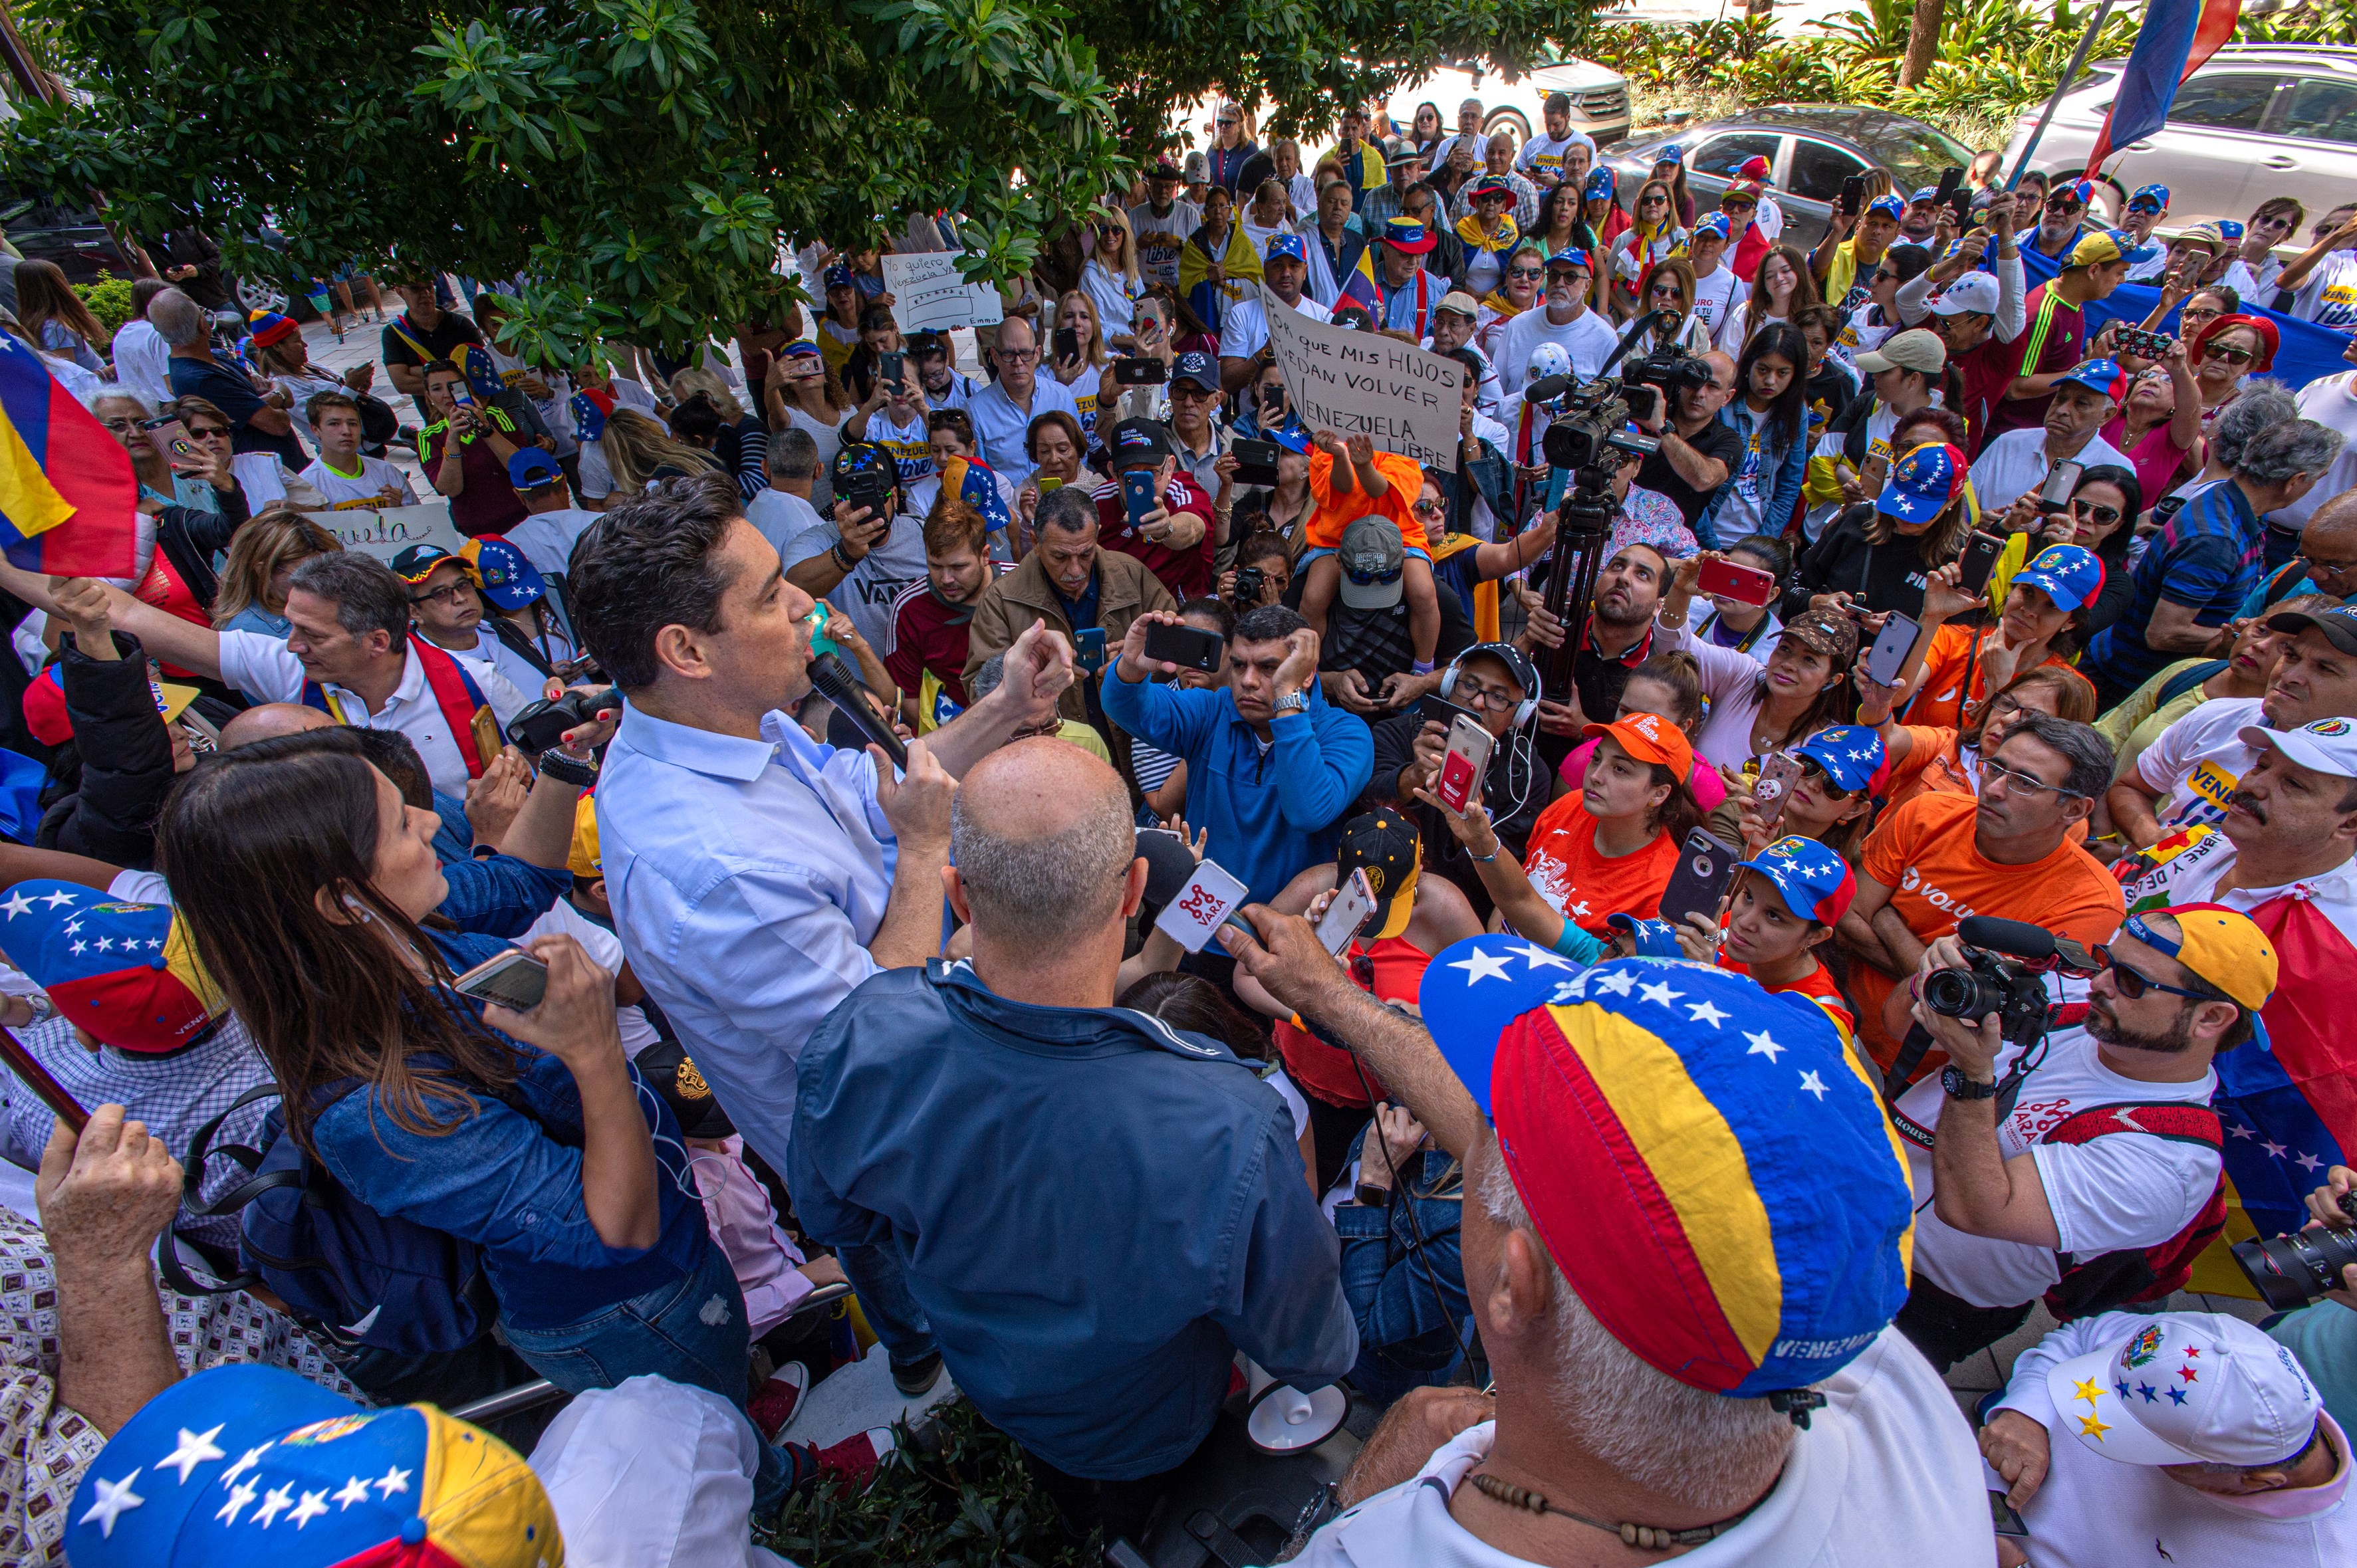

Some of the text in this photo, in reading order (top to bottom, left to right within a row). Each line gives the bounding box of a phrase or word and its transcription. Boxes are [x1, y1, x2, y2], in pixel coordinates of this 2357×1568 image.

[884, 258, 943, 275] Yo quiero
[890, 271, 937, 289] Venezuela
[1265, 291, 1293, 338] POR
[1299, 335, 1331, 358] QUE
[1340, 345, 1380, 364] MIS
[1388, 348, 1456, 388] HIJOS
[1270, 324, 1438, 413] PUEDAN VOLVER
[1281, 358, 1416, 441] VENEZUELA
[898, 457, 932, 479] ibre
[329, 515, 432, 545] uela
[1354, 552, 1387, 564] BASS PRO
[851, 577, 915, 605] VAN
[1638, 722, 1659, 738] CANSA
[2146, 869, 2168, 890] DE
[2173, 862, 2185, 875] Y
[1920, 882, 1975, 919] VOLU
[1197, 899, 1227, 926] VARA
[1995, 964, 2013, 981] Canon
[2021, 1002, 2032, 1012] EOS
[1894, 1117, 1934, 1145] Canon
[2013, 1101, 2039, 1145] VARA
[2006, 1131, 2019, 1151] ALLIANCE
[2010, 1128, 2023, 1150] AMERICAN
